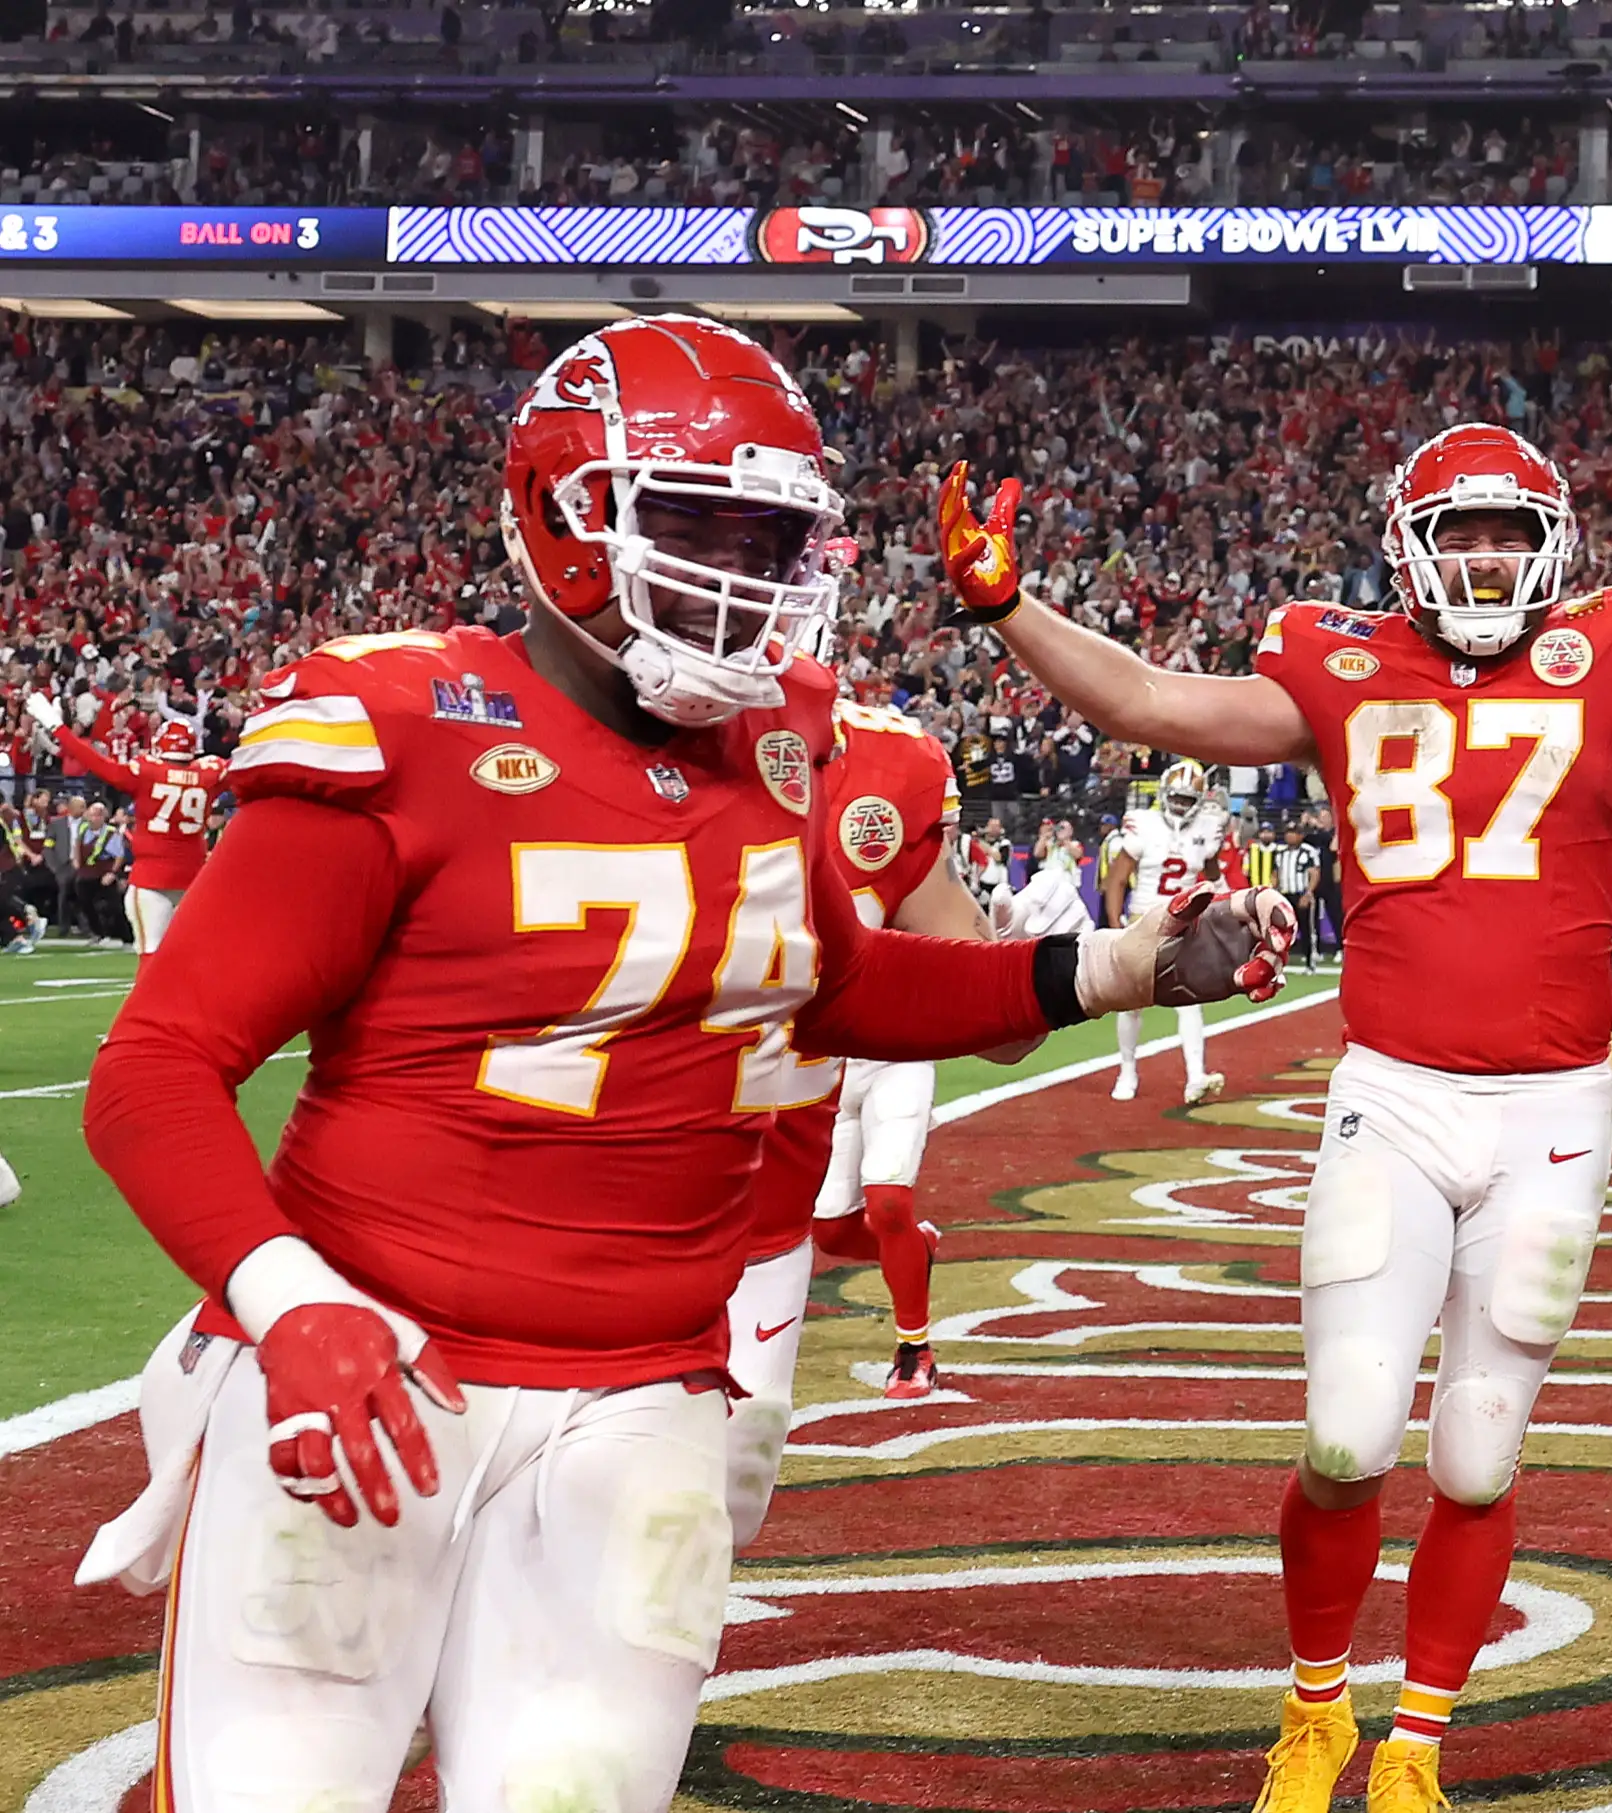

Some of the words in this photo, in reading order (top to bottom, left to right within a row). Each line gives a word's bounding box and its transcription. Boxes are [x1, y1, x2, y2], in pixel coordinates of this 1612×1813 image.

[1, 213, 27, 251] &
[33, 215, 59, 251] 3
[180, 222, 244, 245] BALL
[250, 222, 293, 245] ON
[296, 217, 320, 250] 3
[1072, 217, 1203, 254] SUPER
[1220, 217, 1349, 253] BOWL
[1360, 215, 1440, 253] LVIII
[1339, 657, 1366, 671] NKH
[496, 758, 539, 779] NKH
[147, 782, 208, 835] 79
[1344, 699, 1584, 884] 87
[1156, 857, 1188, 896] 2
[474, 835, 847, 1119] 74
